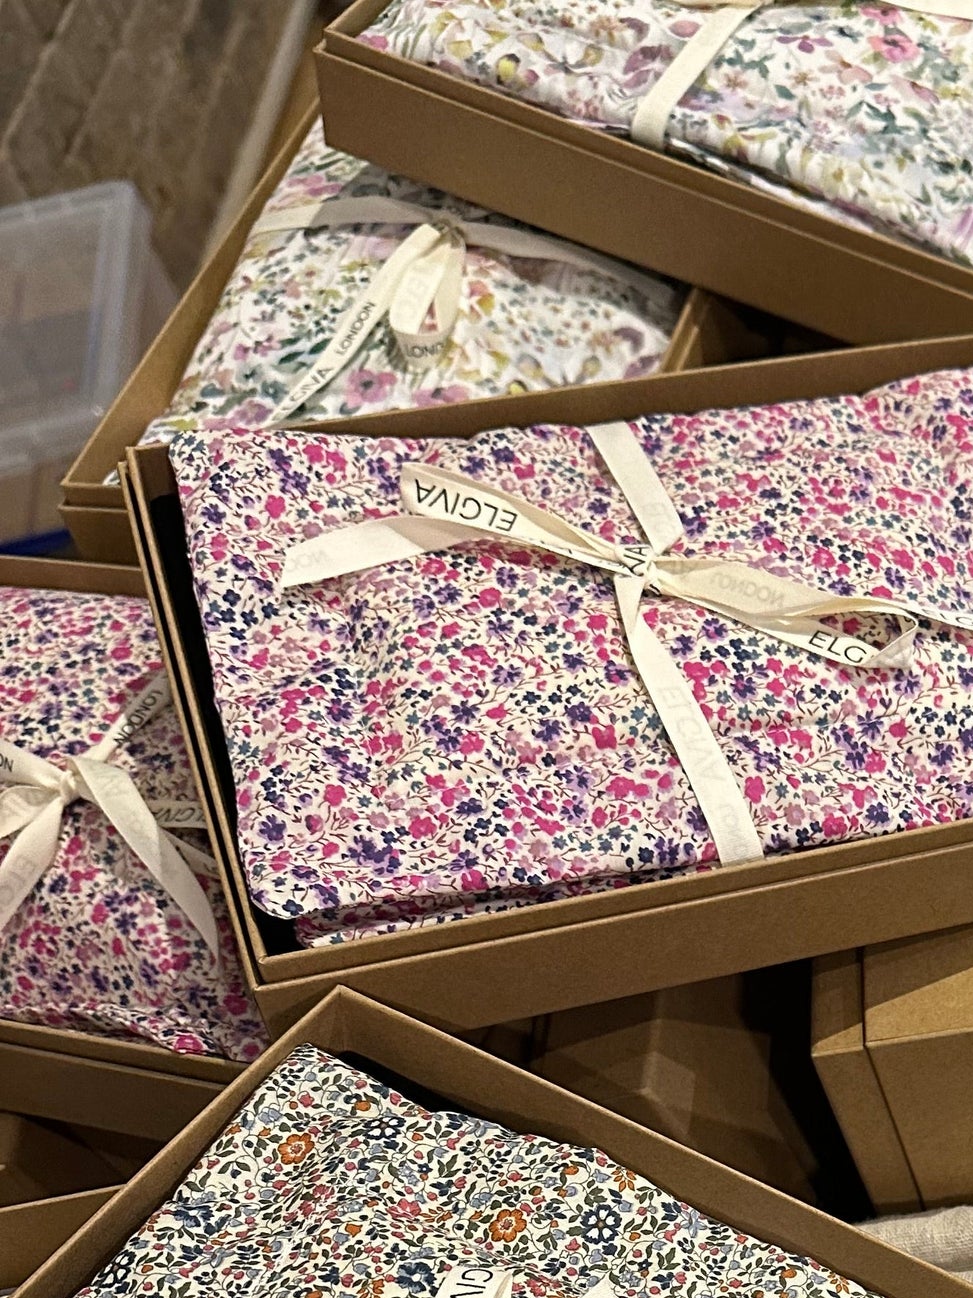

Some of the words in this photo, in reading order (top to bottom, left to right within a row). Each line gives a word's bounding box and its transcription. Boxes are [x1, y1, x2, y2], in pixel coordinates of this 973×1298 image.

[338, 301, 376, 355] LONDON
[414, 478, 518, 533] ELGIVA
[114, 690, 163, 743] LONDON
